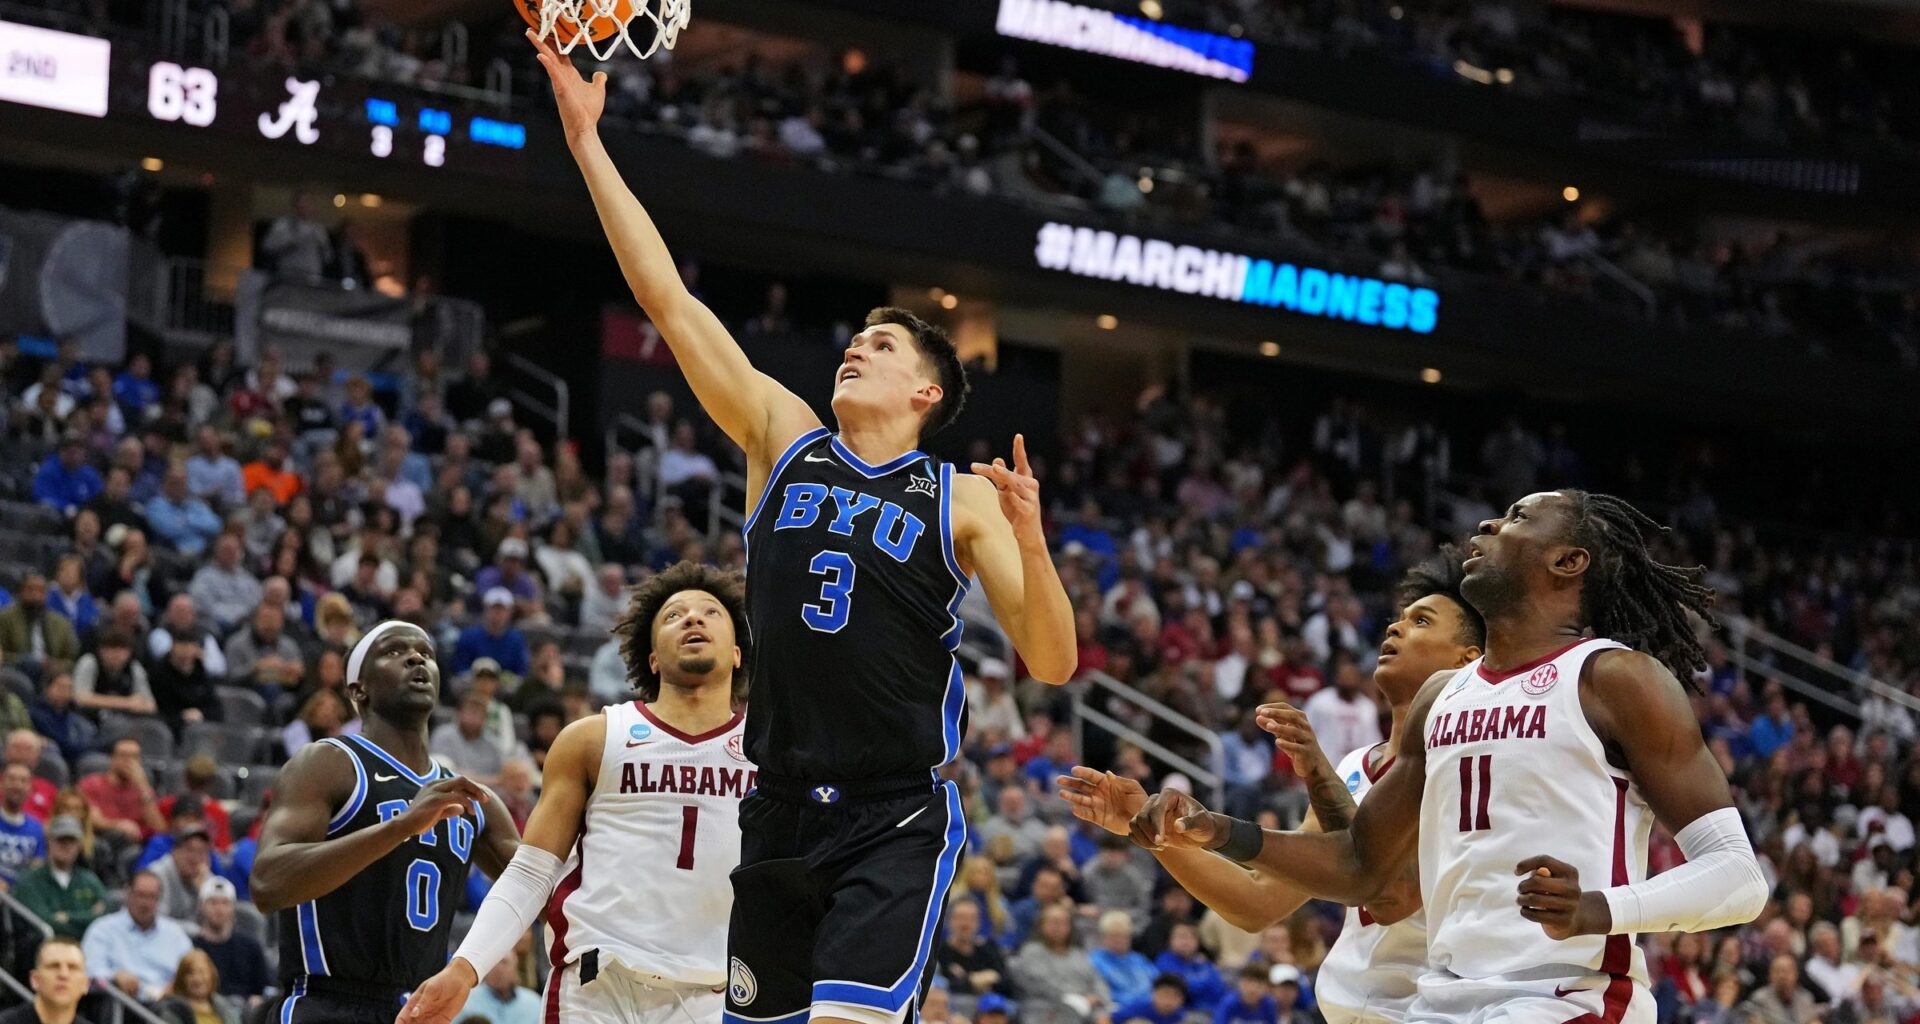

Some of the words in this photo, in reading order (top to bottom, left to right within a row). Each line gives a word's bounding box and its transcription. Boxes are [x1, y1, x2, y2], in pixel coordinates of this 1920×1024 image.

[8, 51, 57, 78] 2ND
[148, 61, 217, 127] 63
[774, 482, 926, 563] BYU
[801, 549, 856, 634] 3
[1428, 705, 1547, 749] ALABAMA
[1459, 754, 1492, 832] 11
[676, 805, 699, 870] 1
[406, 858, 442, 932] 0
